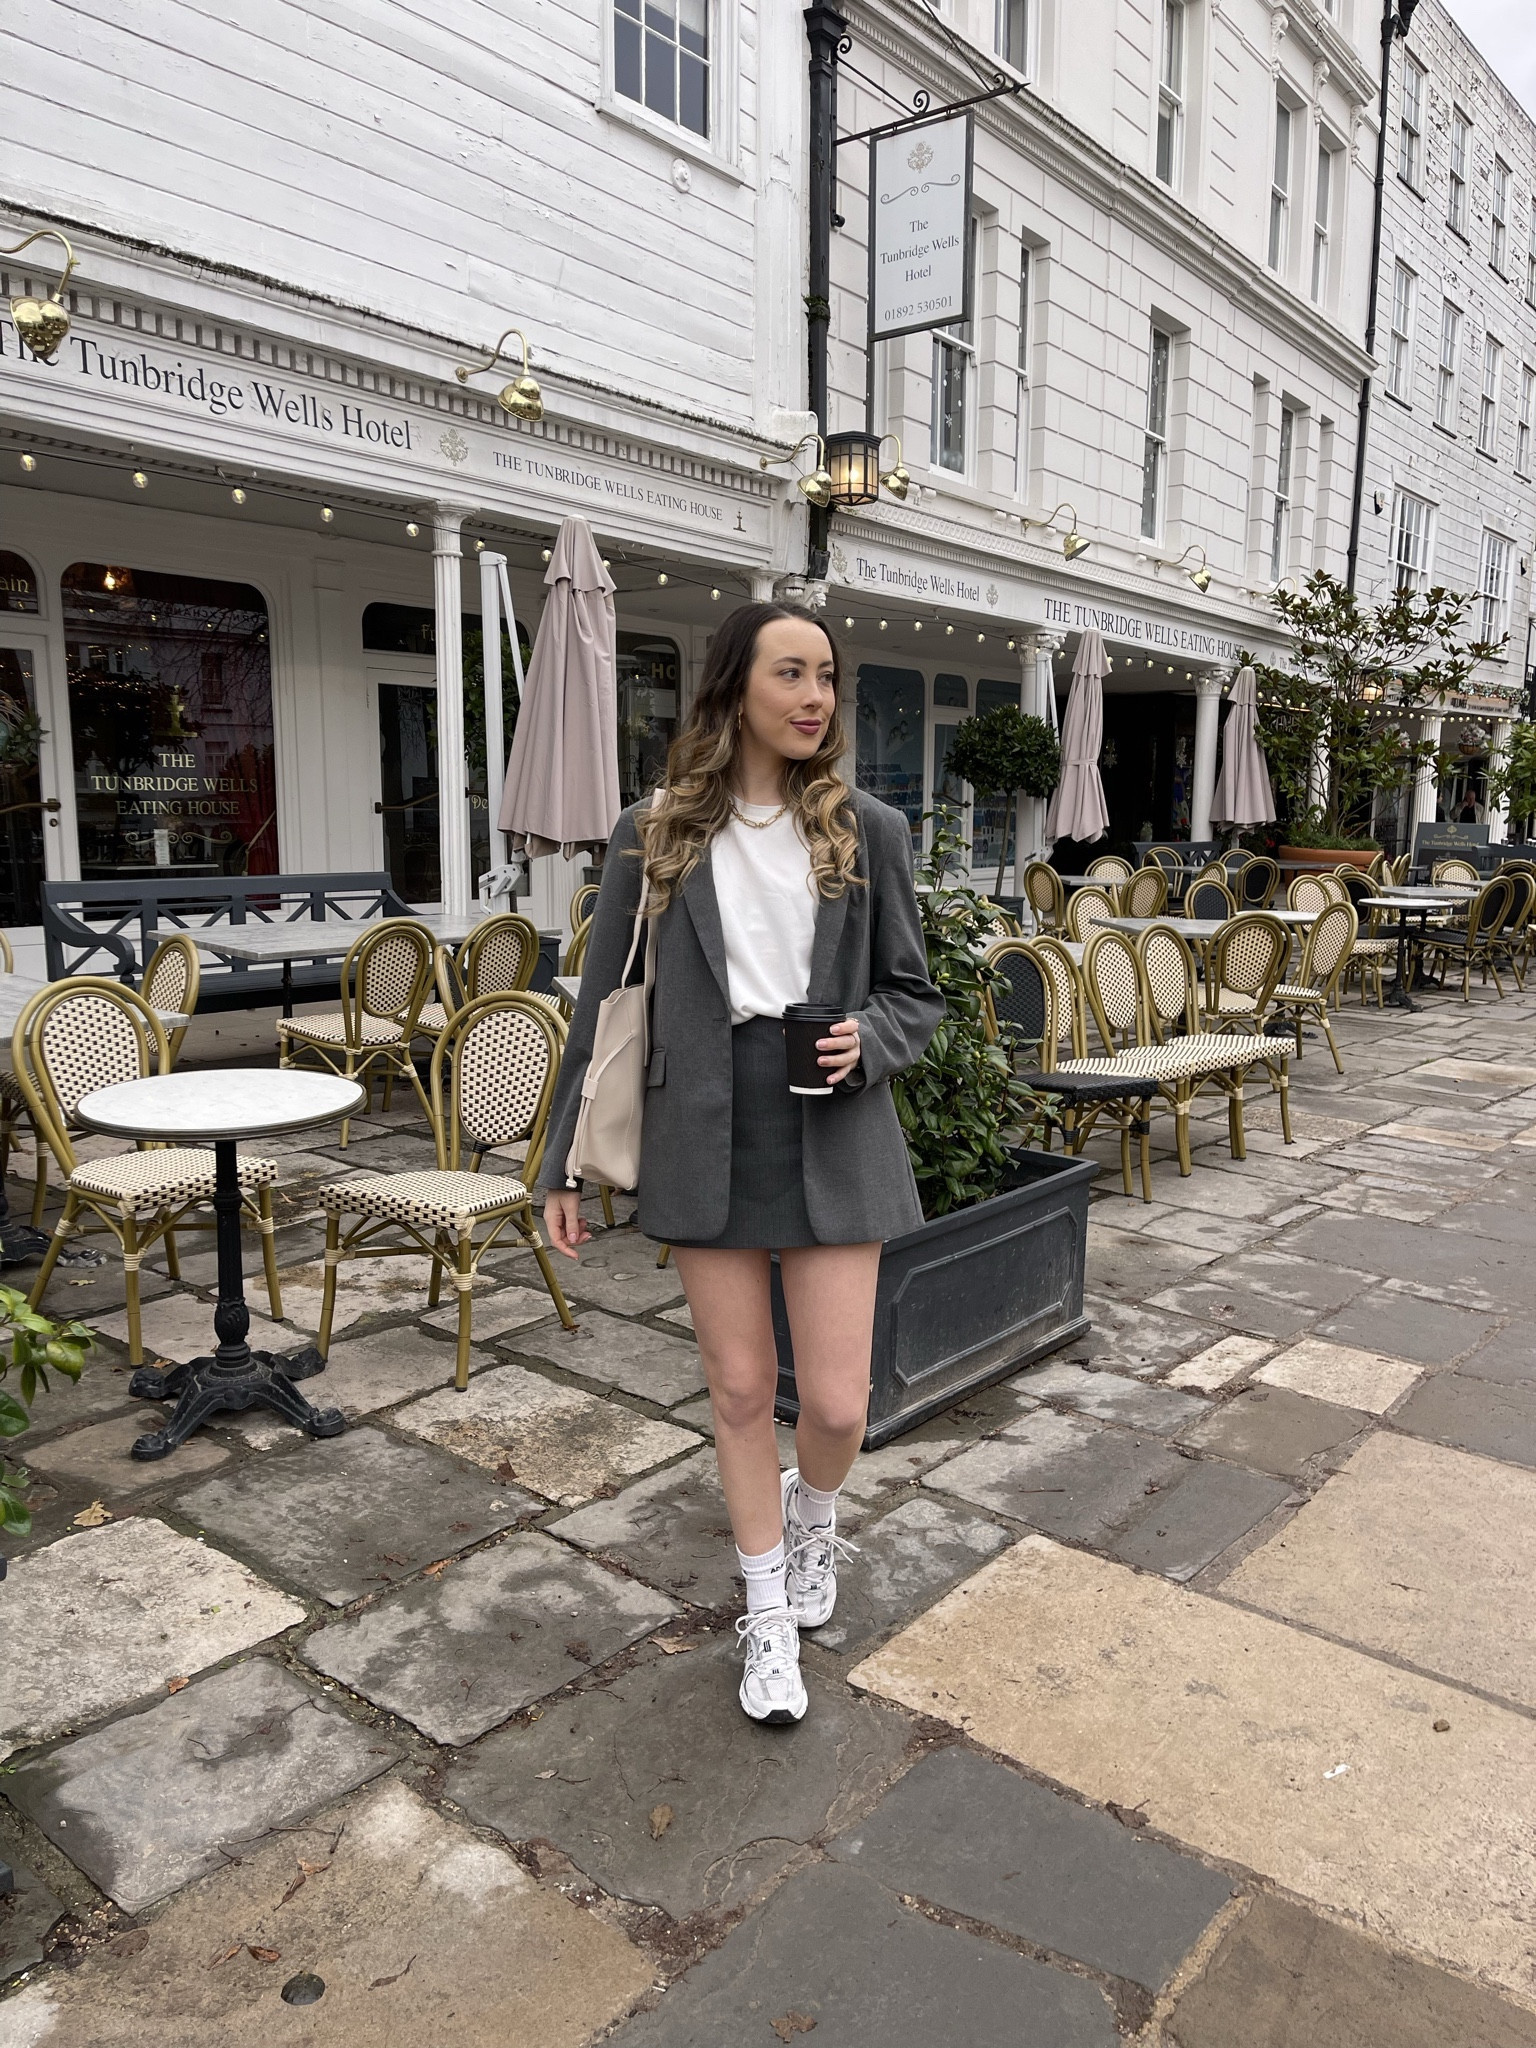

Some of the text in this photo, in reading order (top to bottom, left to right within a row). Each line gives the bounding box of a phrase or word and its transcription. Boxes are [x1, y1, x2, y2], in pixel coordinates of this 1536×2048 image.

[909, 219, 929, 233] The
[880, 235, 960, 265] Tunbridge Wells
[905, 265, 931, 282] Hotel
[884, 295, 953, 321] 01892 530501
[70, 336, 244, 415] Tunbridge
[252, 381, 333, 432] Wells
[341, 403, 412, 450] Hotel
[493, 451, 723, 521] THE TUNBRIDGE WELLS EATING HOUSE
[856, 557, 980, 602] The Tunbridge Wells Hotel
[1044, 598, 1071, 623] THE
[1074, 606, 1142, 639] TUNBRIDGE
[1145, 621, 1179, 647] WELLS
[1181, 630, 1215, 656] EATING
[158, 752, 196, 768] THE
[90, 775, 258, 793] TUNBRIDGE WELLS
[116, 800, 241, 816] EATING HOUSE
